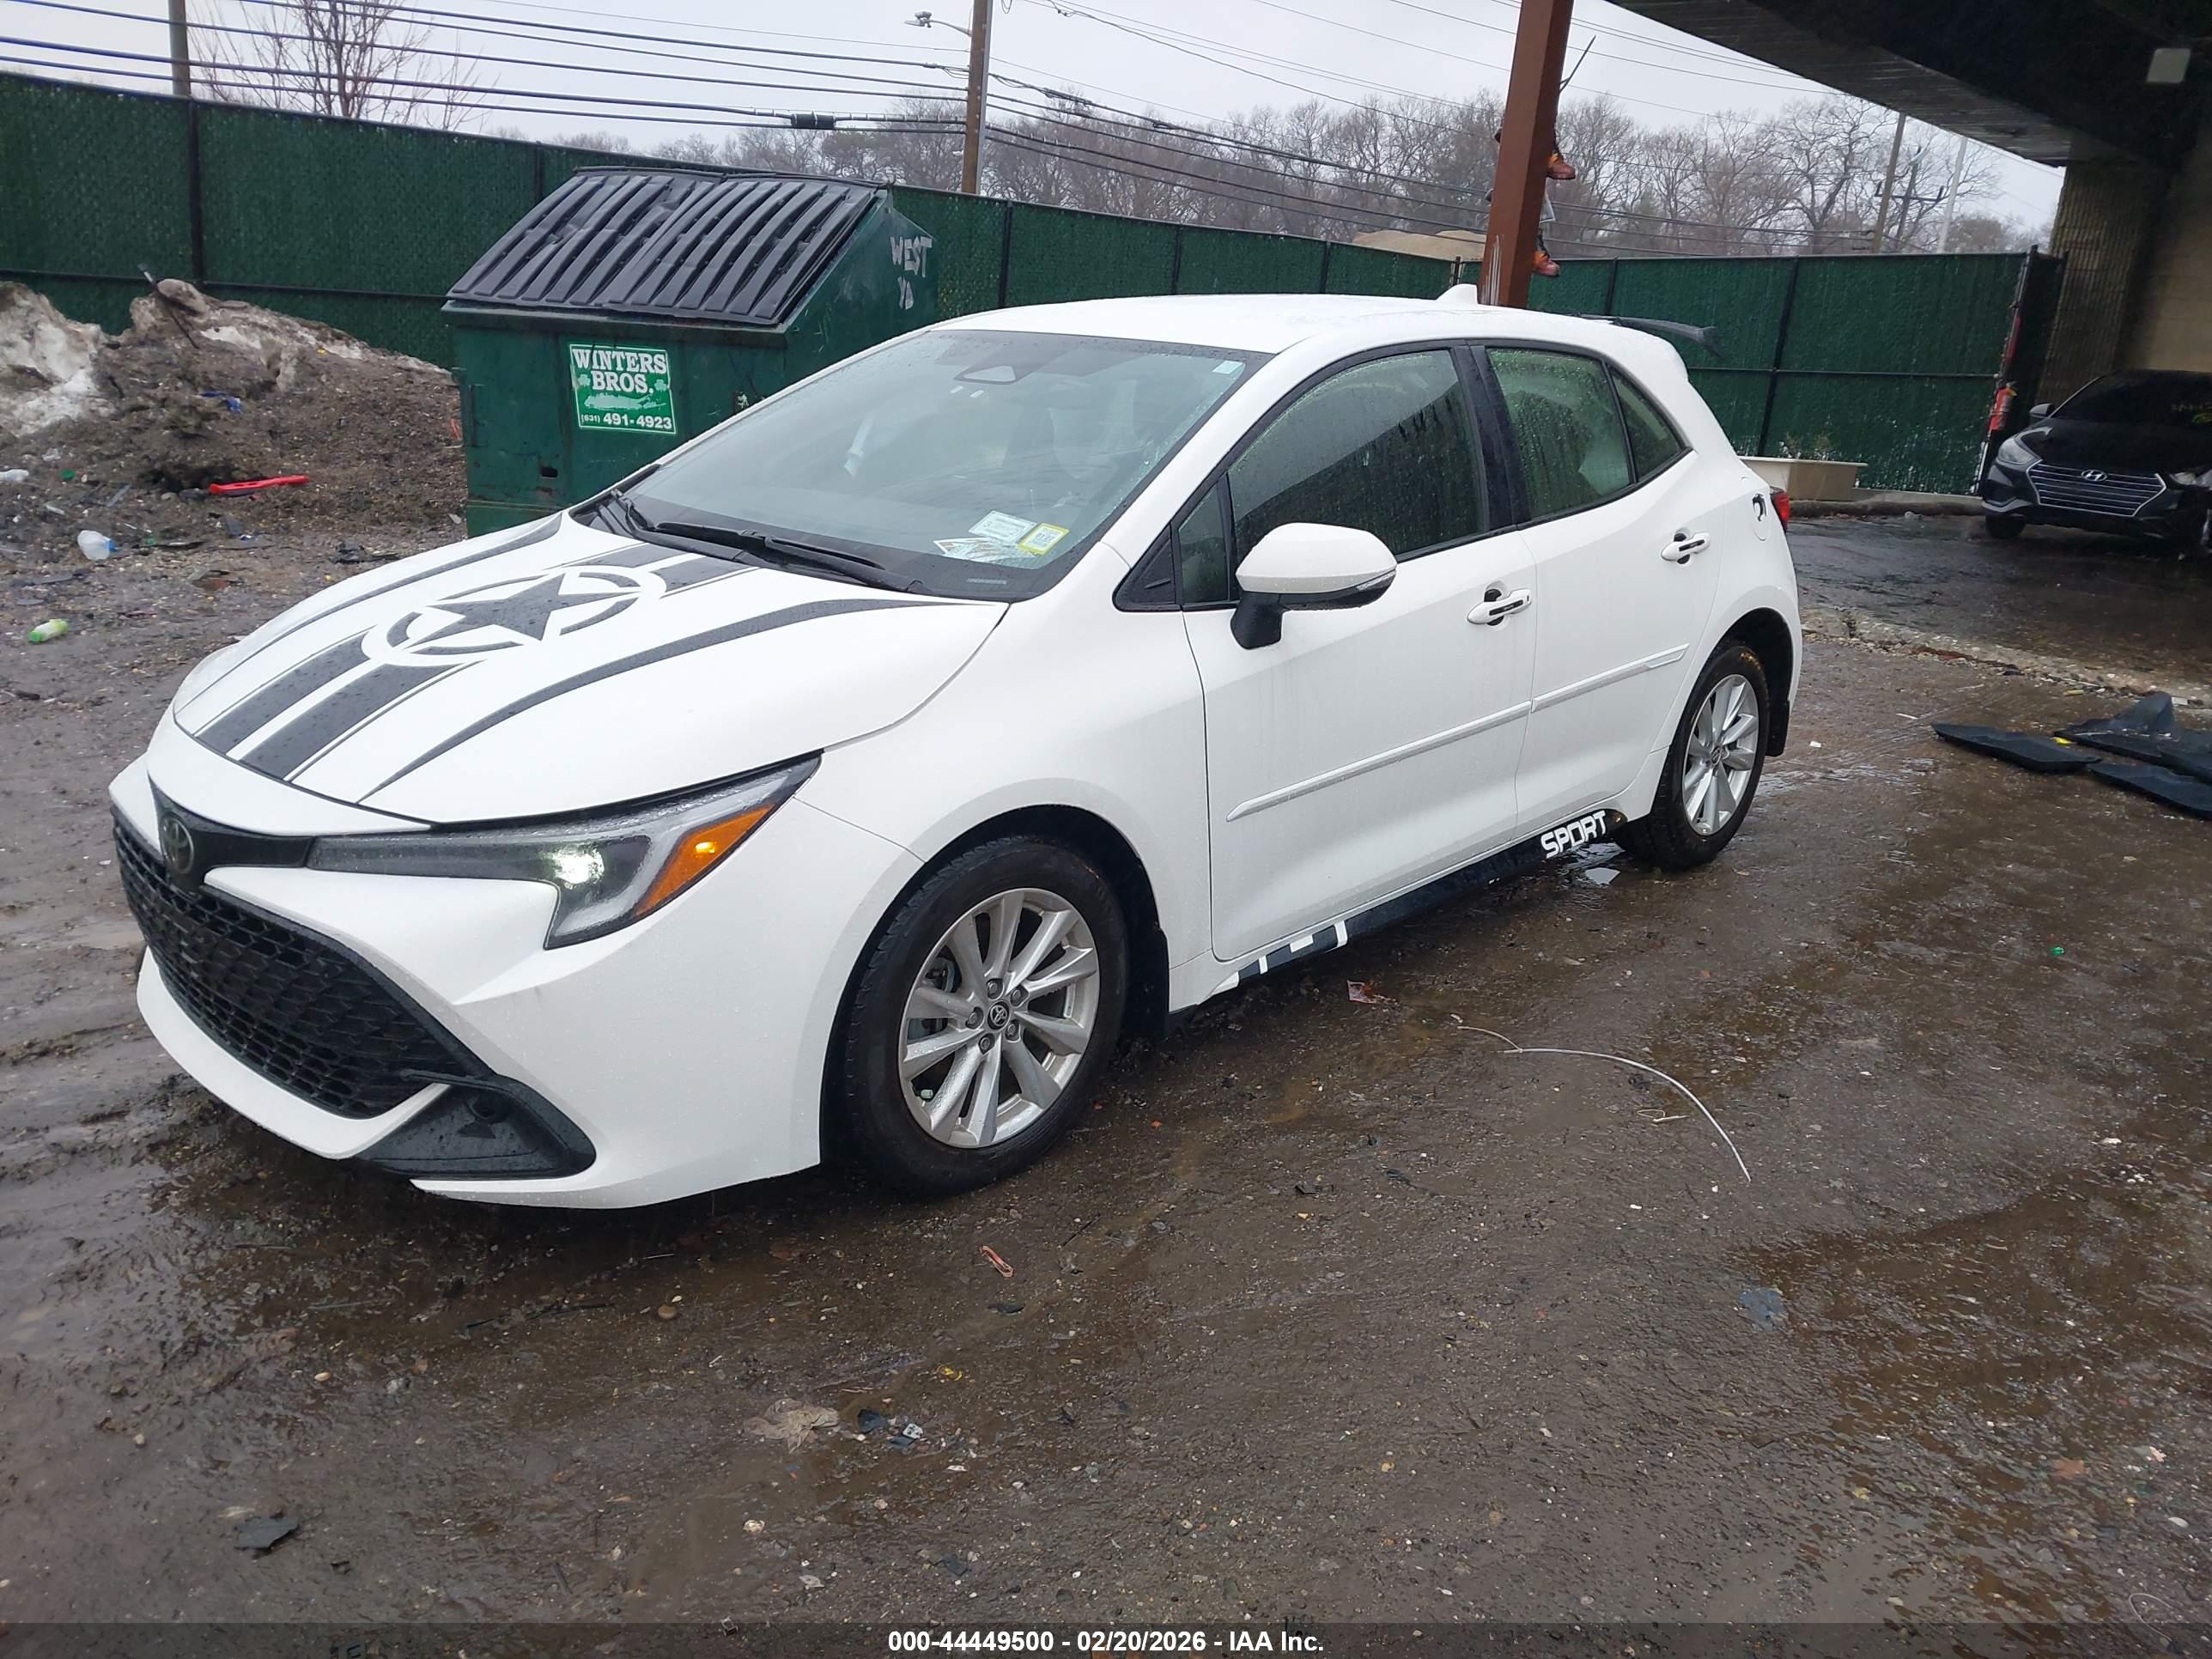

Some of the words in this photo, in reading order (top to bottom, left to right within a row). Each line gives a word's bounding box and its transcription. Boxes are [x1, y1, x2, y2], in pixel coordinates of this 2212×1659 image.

[890, 236, 932, 277] WEST
[573, 349, 666, 374] WINTERS
[591, 371, 653, 393] BROS.
[581, 414, 600, 423] (631)
[603, 413, 672, 428] 491-4923
[1541, 810, 1606, 858] SPORT
